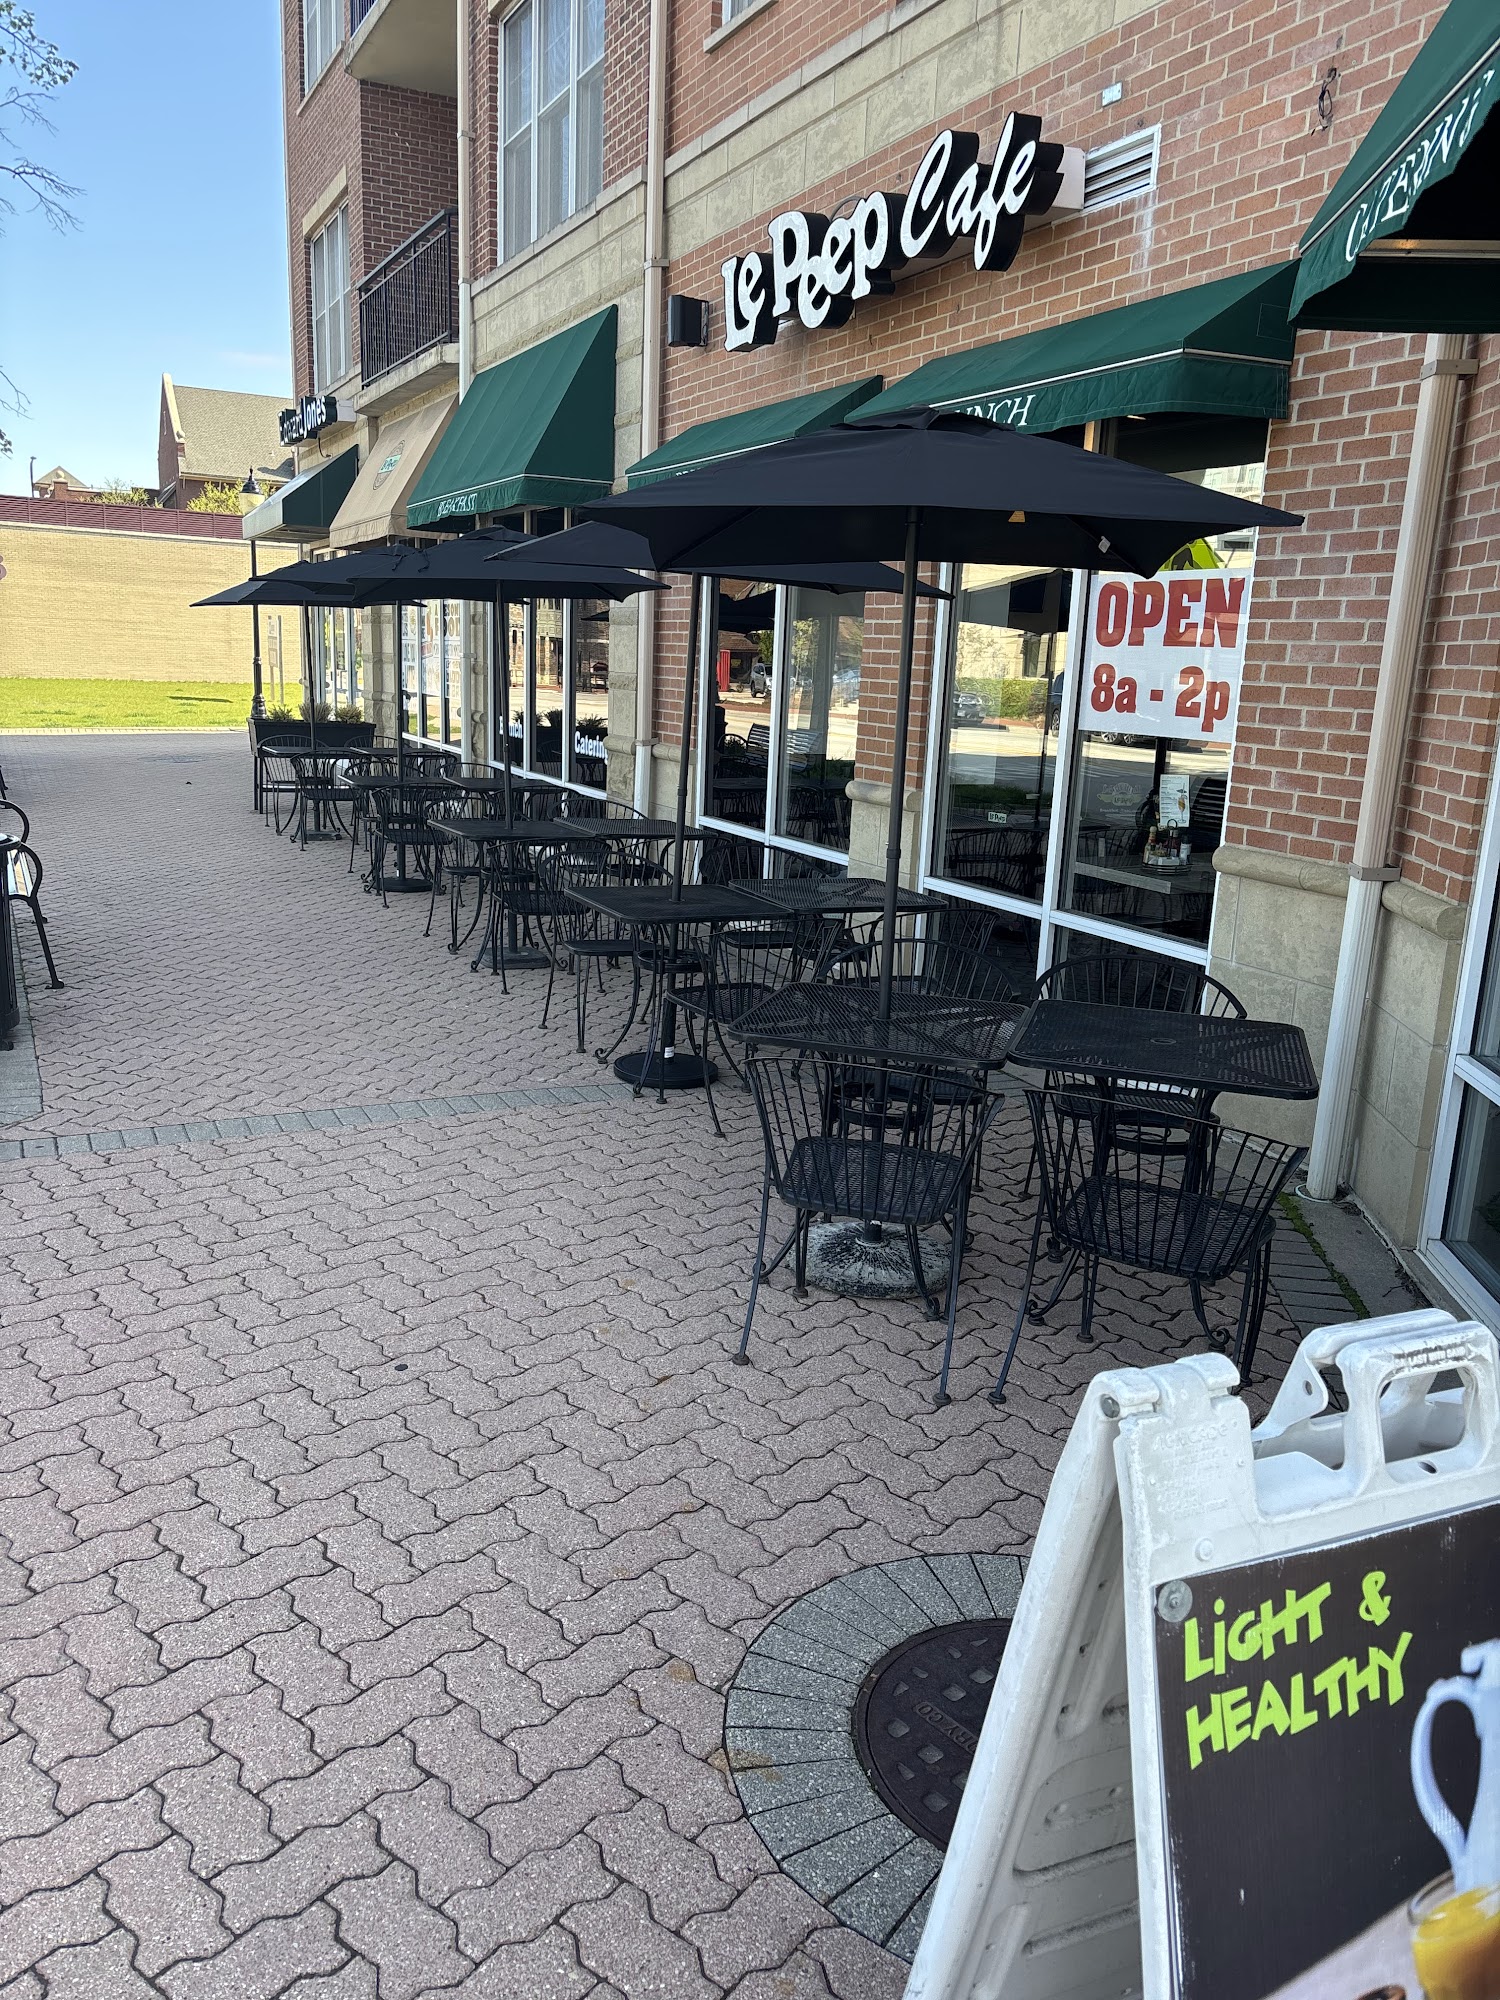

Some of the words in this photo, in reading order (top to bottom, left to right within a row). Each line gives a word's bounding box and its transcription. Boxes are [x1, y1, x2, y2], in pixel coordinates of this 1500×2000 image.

[721, 251, 766, 352] Le
[767, 209, 890, 330] Peep
[900, 111, 1037, 272] Cafe
[303, 395, 327, 439] Jones
[1095, 577, 1246, 649] OPEN
[499, 715, 523, 739] Bunch
[1090, 663, 1137, 714] 8a
[1149, 689, 1164, 702] -
[1174, 665, 1231, 733] 2p
[1358, 1570, 1392, 1627] &
[1185, 1631, 1414, 1771] HEALTHY
